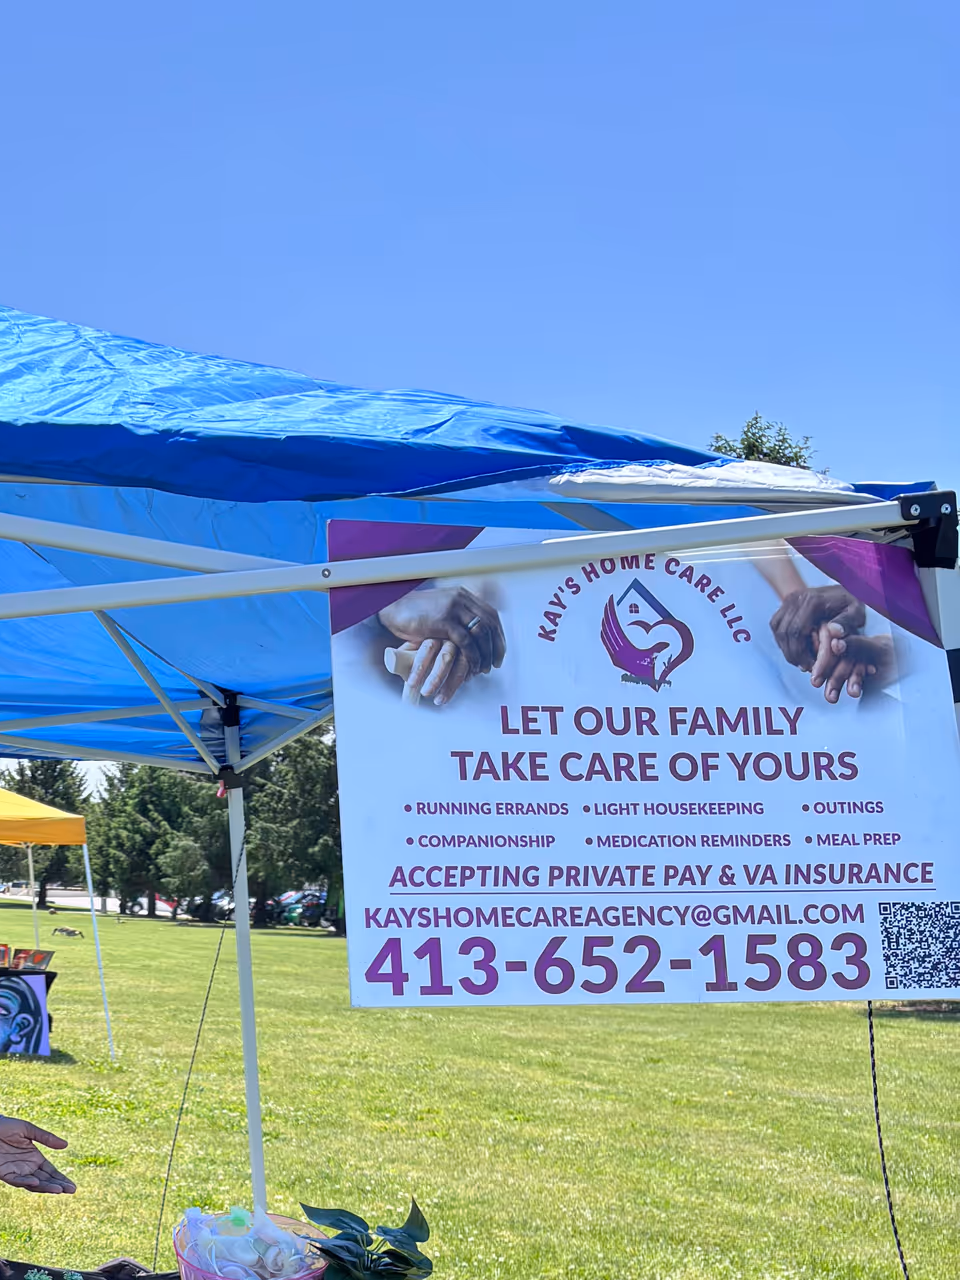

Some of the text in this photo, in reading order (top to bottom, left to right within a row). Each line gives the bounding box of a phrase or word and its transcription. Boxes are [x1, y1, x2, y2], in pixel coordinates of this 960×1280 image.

[537, 552, 752, 643] KAY'S HOME CARE LLC
[500, 705, 804, 737] LET OUR FAMILY
[450, 750, 859, 782] TAKE CARE OF YOURS
[415, 801, 570, 816] RUNNING ERRANDS
[594, 802, 765, 816] LIGHT HOUSEKEEPING
[812, 801, 885, 814] OUTINGS
[417, 834, 556, 848] COMPANIONSHIP
[596, 833, 792, 848] MEDICATION REMINDERS
[816, 832, 902, 847] MEAL PREP
[388, 861, 935, 888] ACCEPTING PRIVATE PAY & VA INSURANCE
[364, 903, 865, 930] KAYSHOMECAREAGENCY@GMAIL.COM
[364, 932, 872, 997] 413-652-1583
